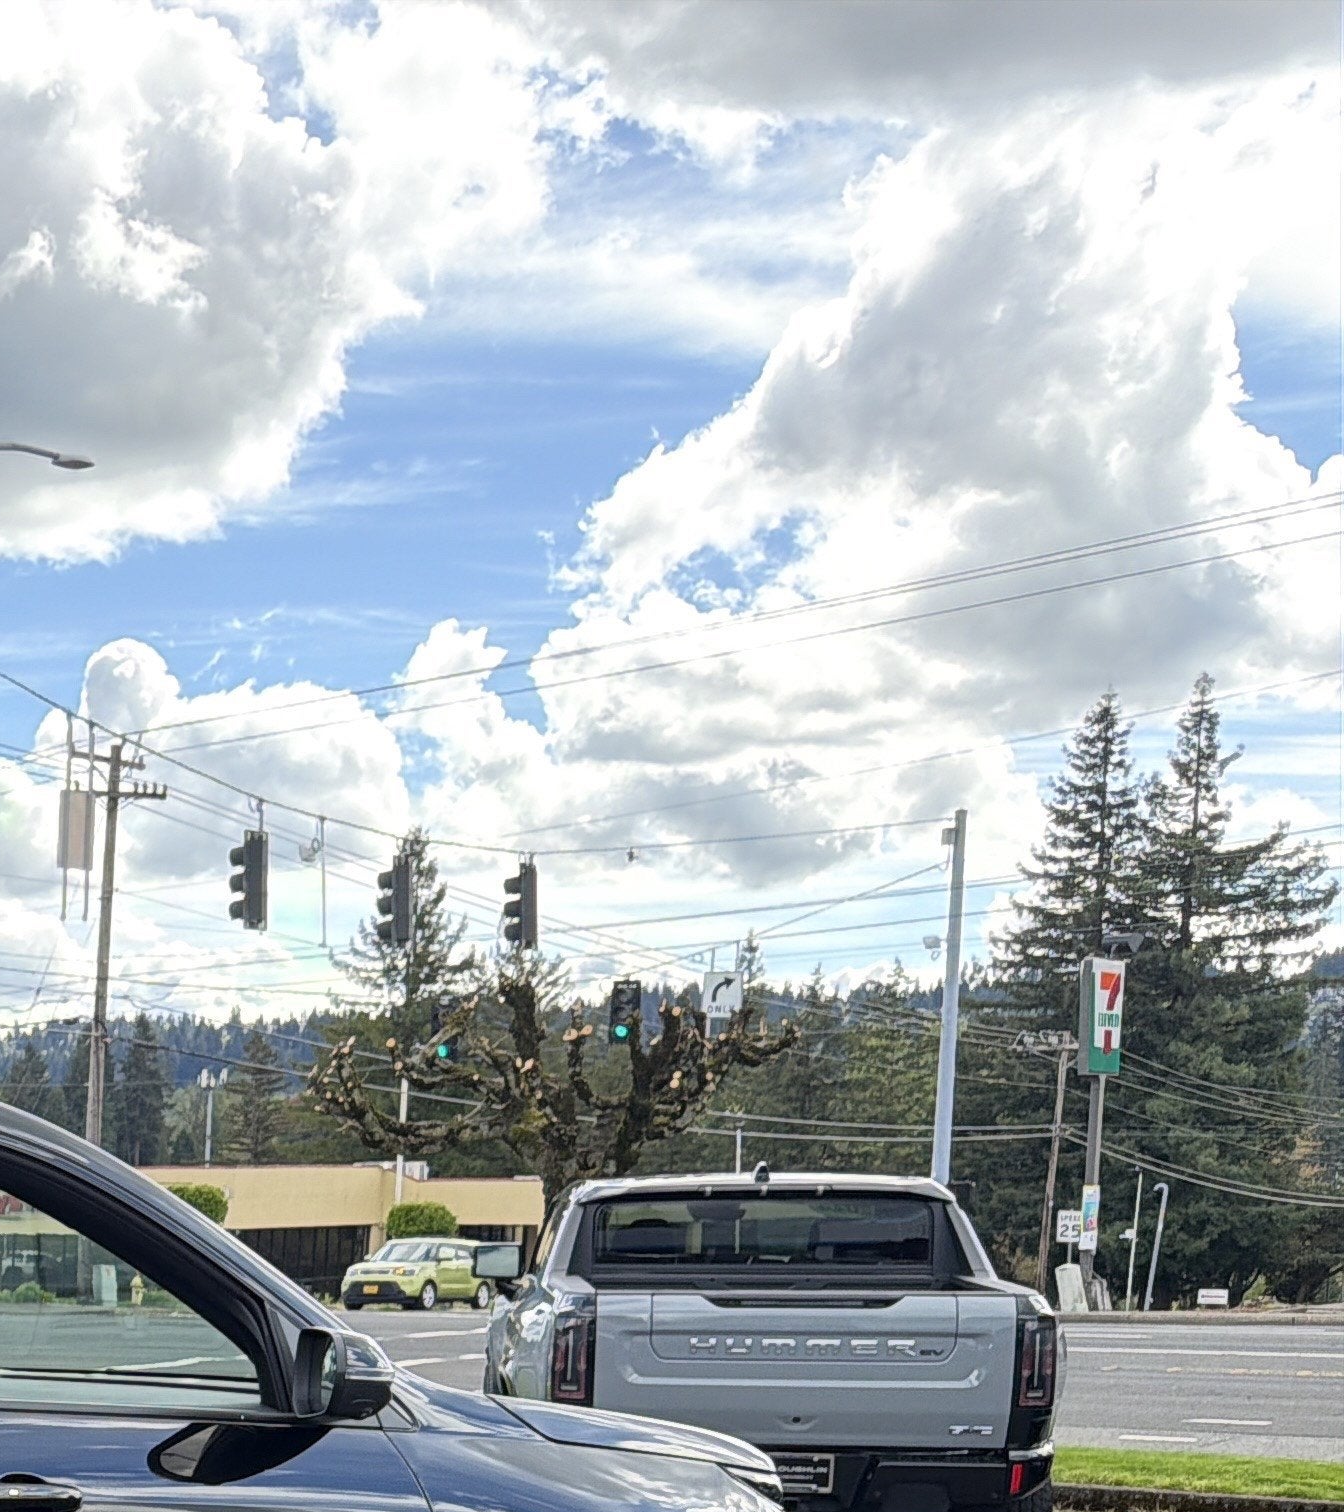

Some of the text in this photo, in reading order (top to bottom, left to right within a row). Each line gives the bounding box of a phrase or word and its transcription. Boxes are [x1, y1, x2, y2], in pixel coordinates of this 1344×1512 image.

[1059, 1223, 1081, 1239] 25
[689, 1337, 916, 1356] HUMMER
[777, 1464, 828, 1474] OUGHLIN
